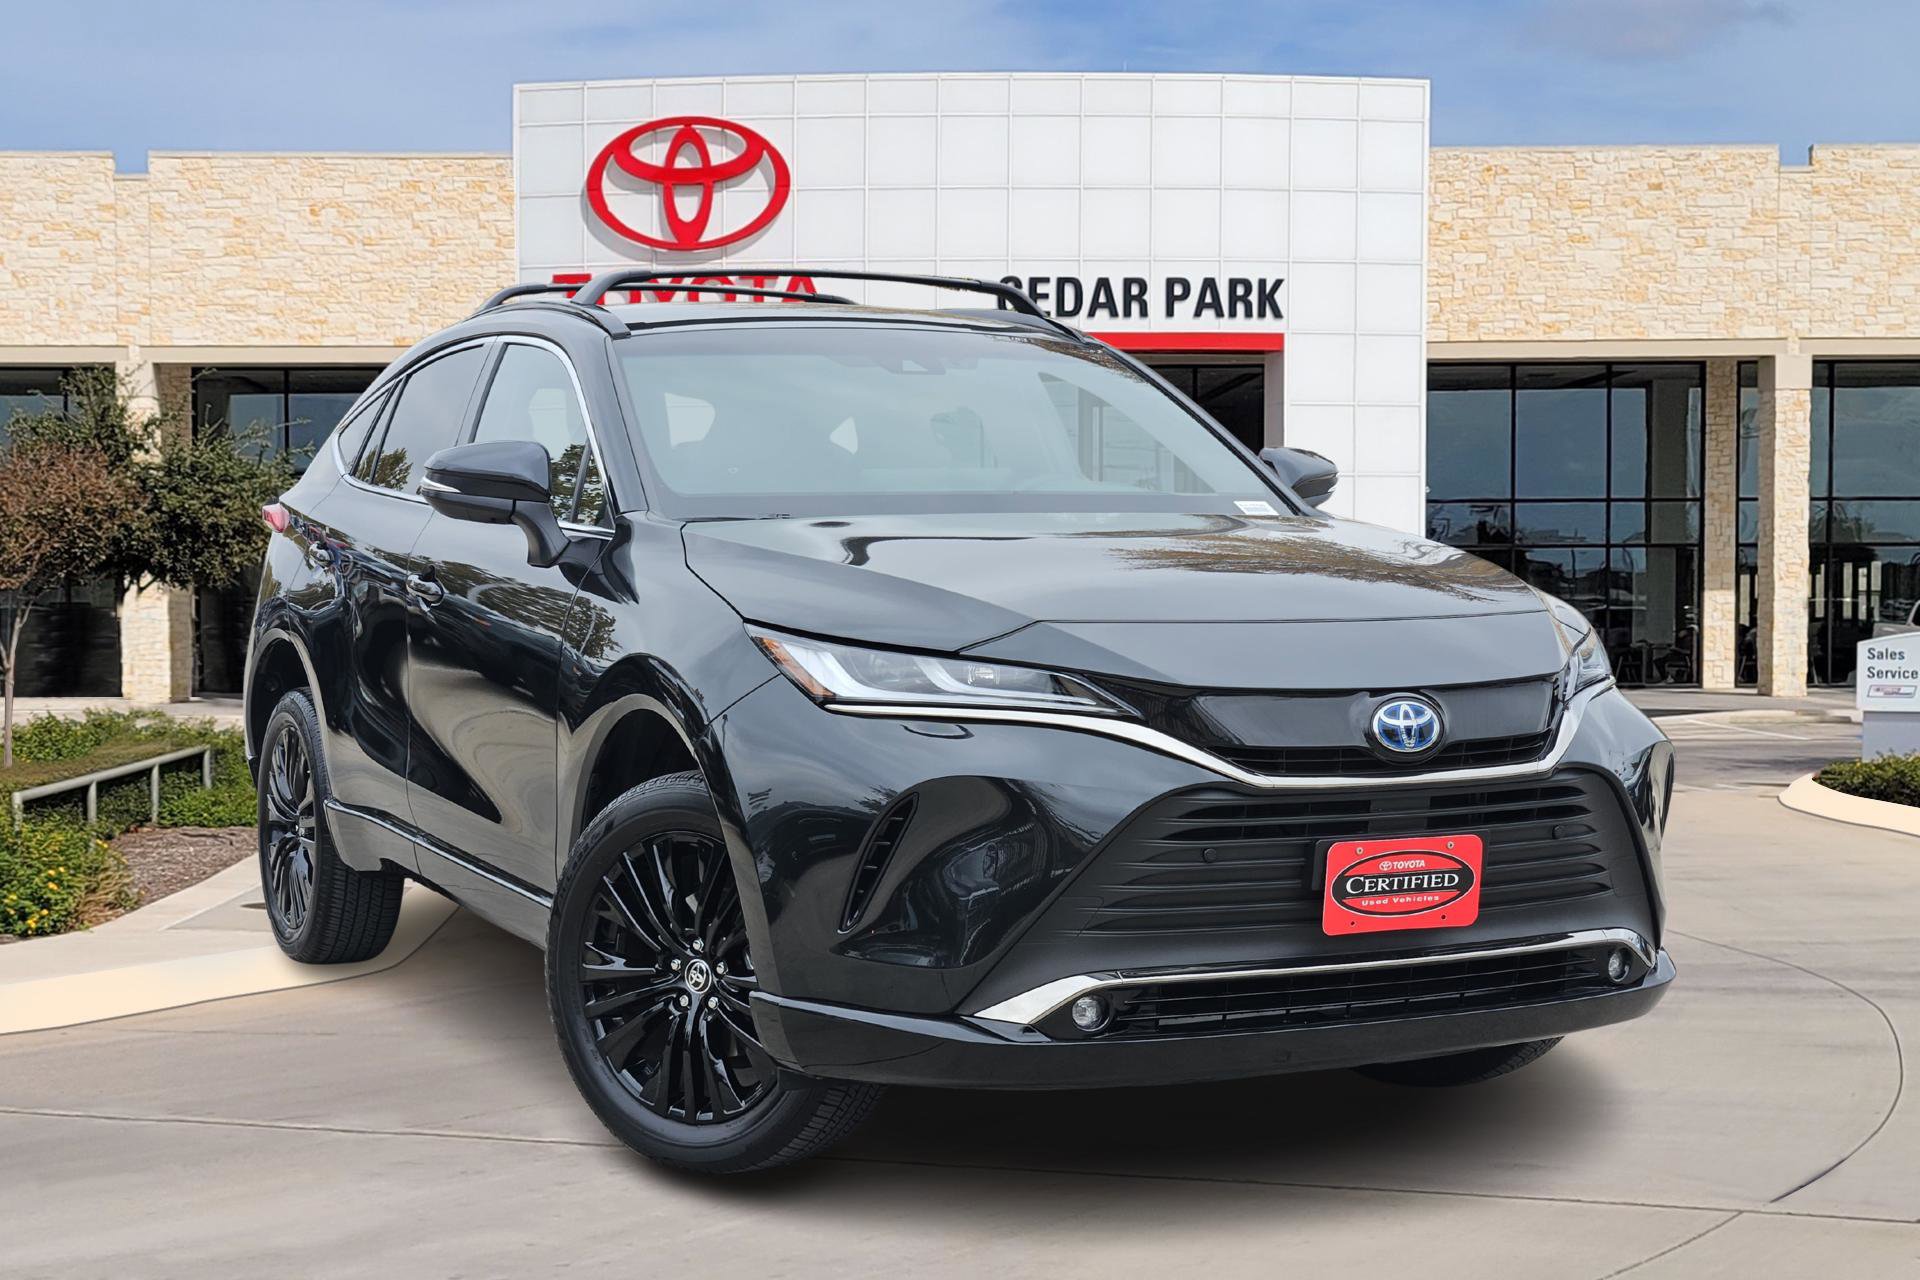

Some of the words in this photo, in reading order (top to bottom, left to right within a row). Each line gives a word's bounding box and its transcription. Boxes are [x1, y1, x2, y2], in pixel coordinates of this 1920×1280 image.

[997, 276, 1148, 318] CEDAR
[1165, 277, 1284, 319] PARK
[1867, 647, 1906, 660] Sales
[1867, 666, 1919, 679] Service
[1392, 860, 1426, 870] TOYOTA
[1345, 873, 1459, 894] CERTIFIED
[1361, 898, 1389, 907] Used
[1392, 895, 1440, 904] Vehicles
